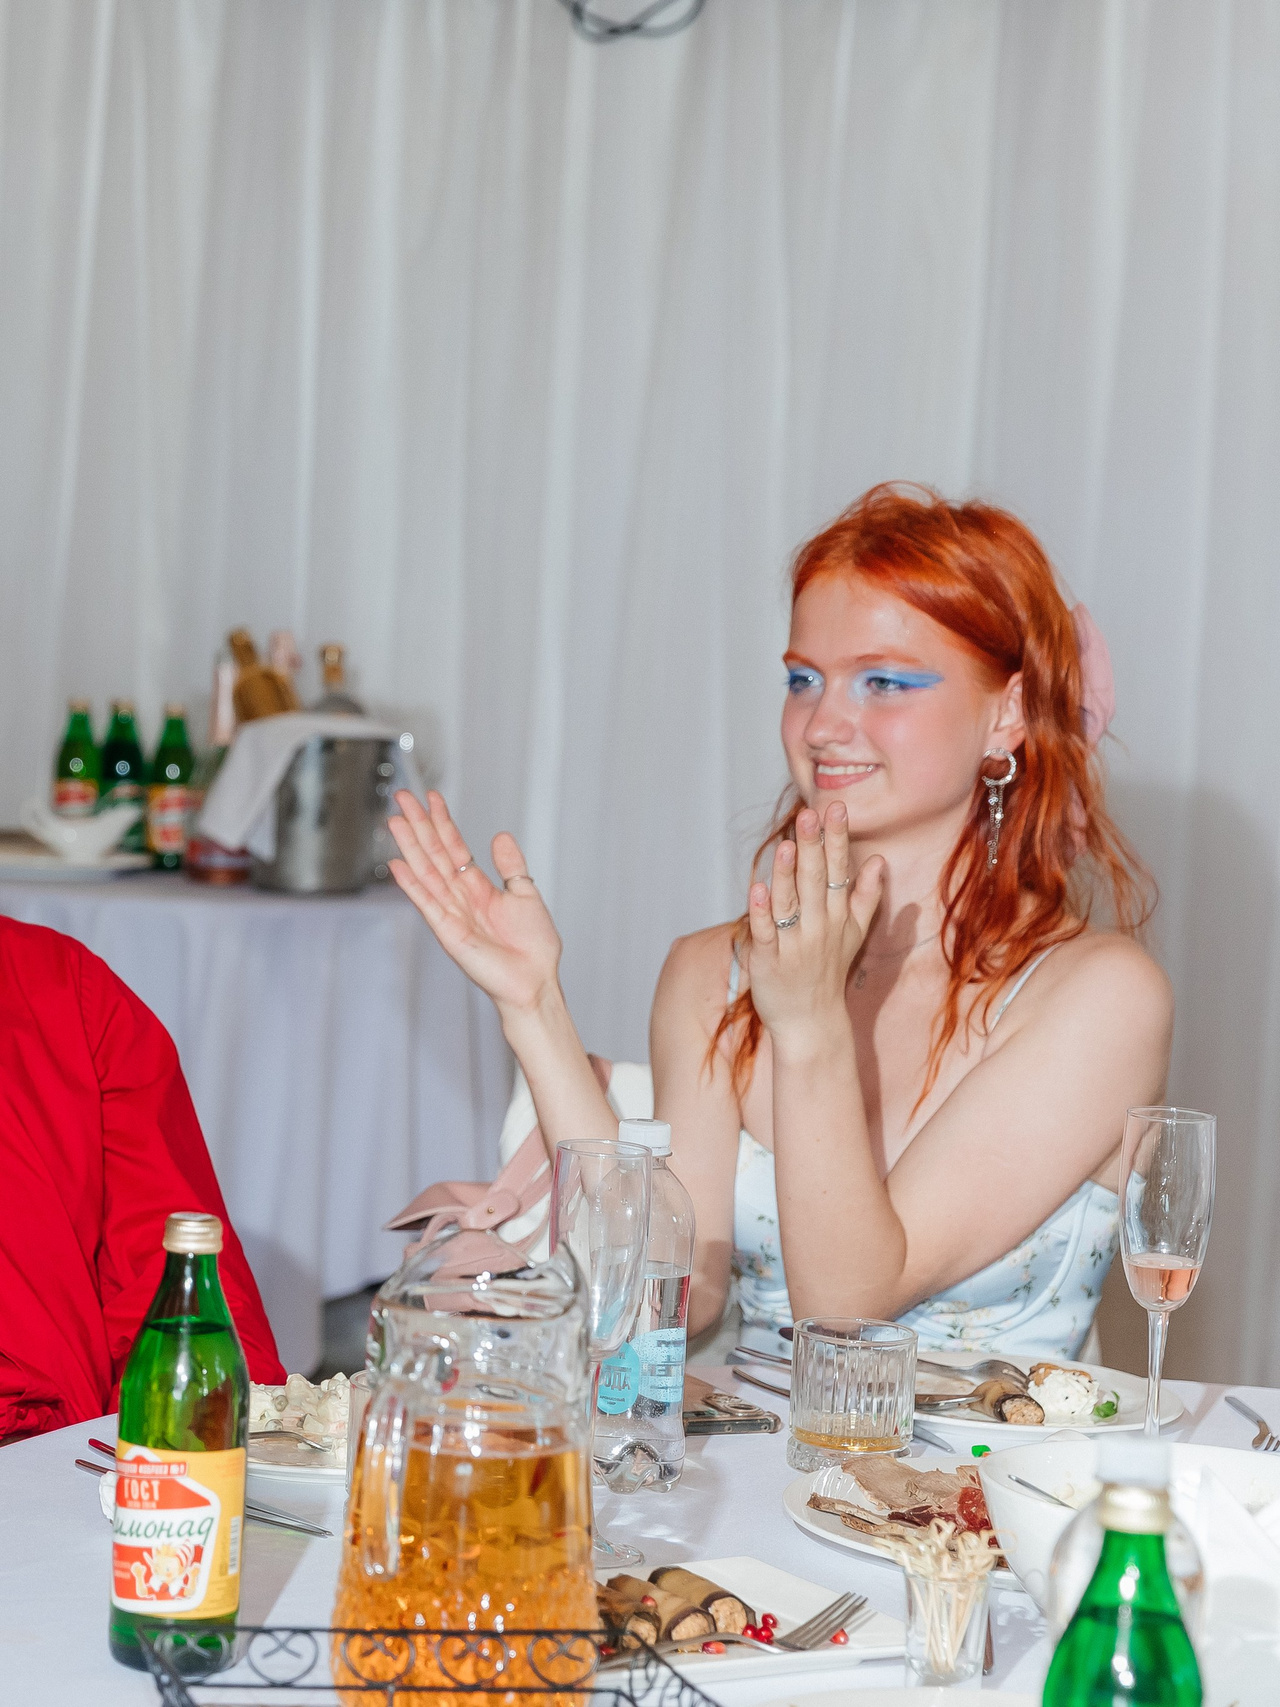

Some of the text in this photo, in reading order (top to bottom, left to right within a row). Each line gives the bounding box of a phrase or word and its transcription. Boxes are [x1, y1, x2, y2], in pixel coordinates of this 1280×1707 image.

[601, 1369, 631, 1391] ОДА
[123, 1478, 160, 1501] ГОСТ
[113, 1517, 215, 1546] имонад
